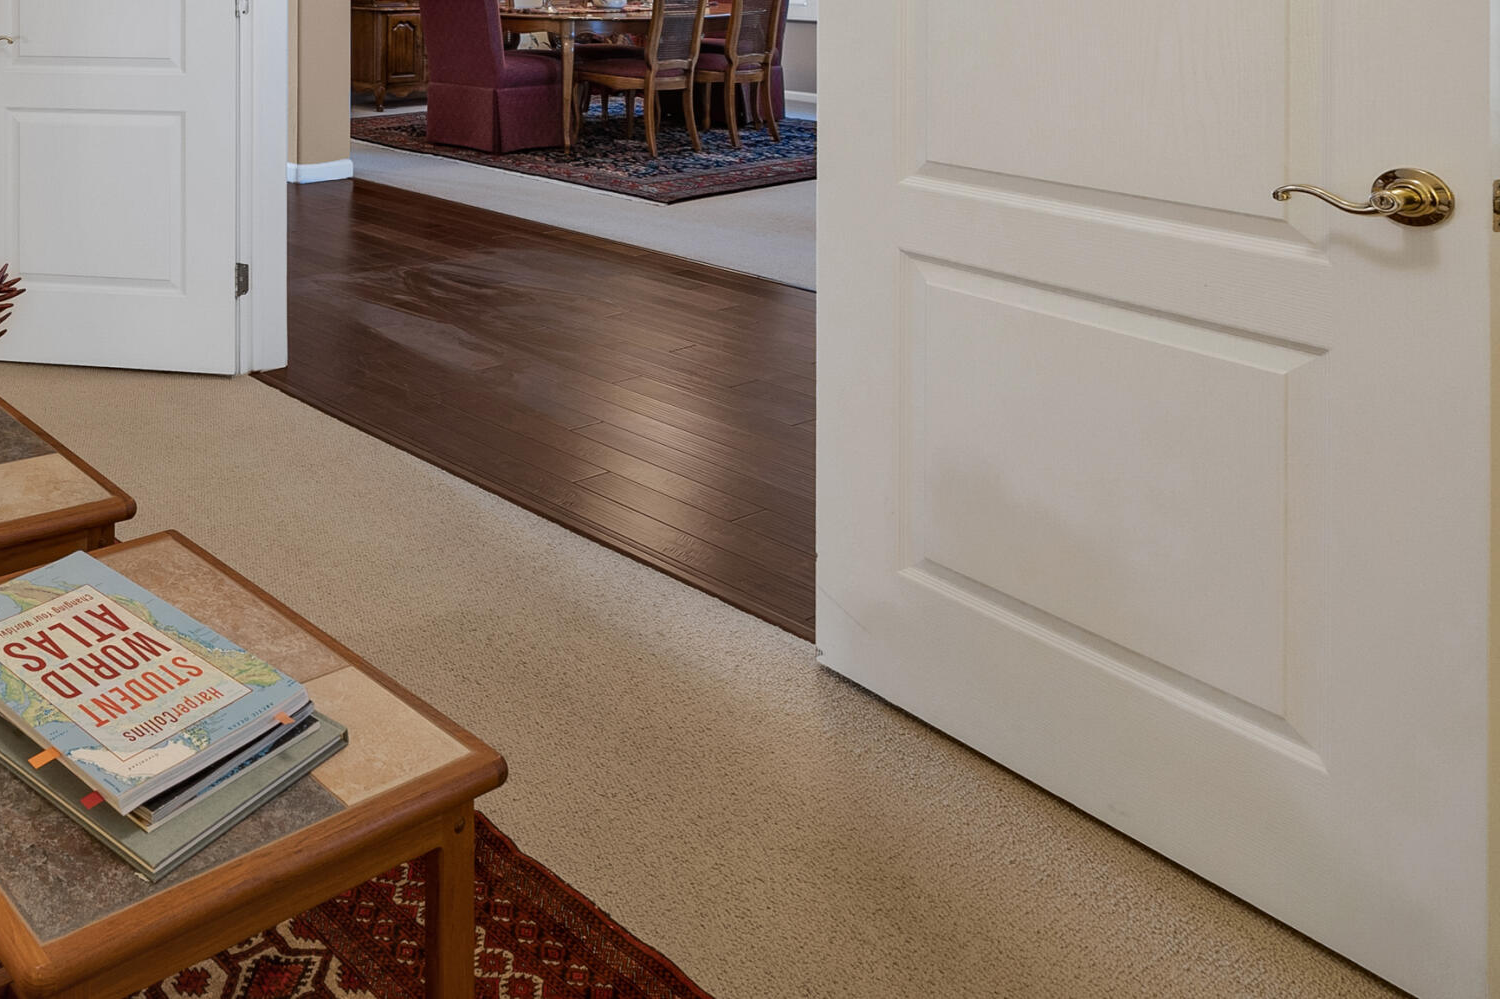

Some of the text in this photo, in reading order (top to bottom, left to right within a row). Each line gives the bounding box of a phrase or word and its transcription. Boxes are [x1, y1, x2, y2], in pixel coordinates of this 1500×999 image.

[34, 610, 52, 623] Your
[52, 593, 94, 615] Changing
[2, 602, 141, 672] ATLAS
[41, 630, 172, 699] WORLD
[76, 655, 204, 727] STUDENT
[122, 685, 224, 743] HarperCollins
